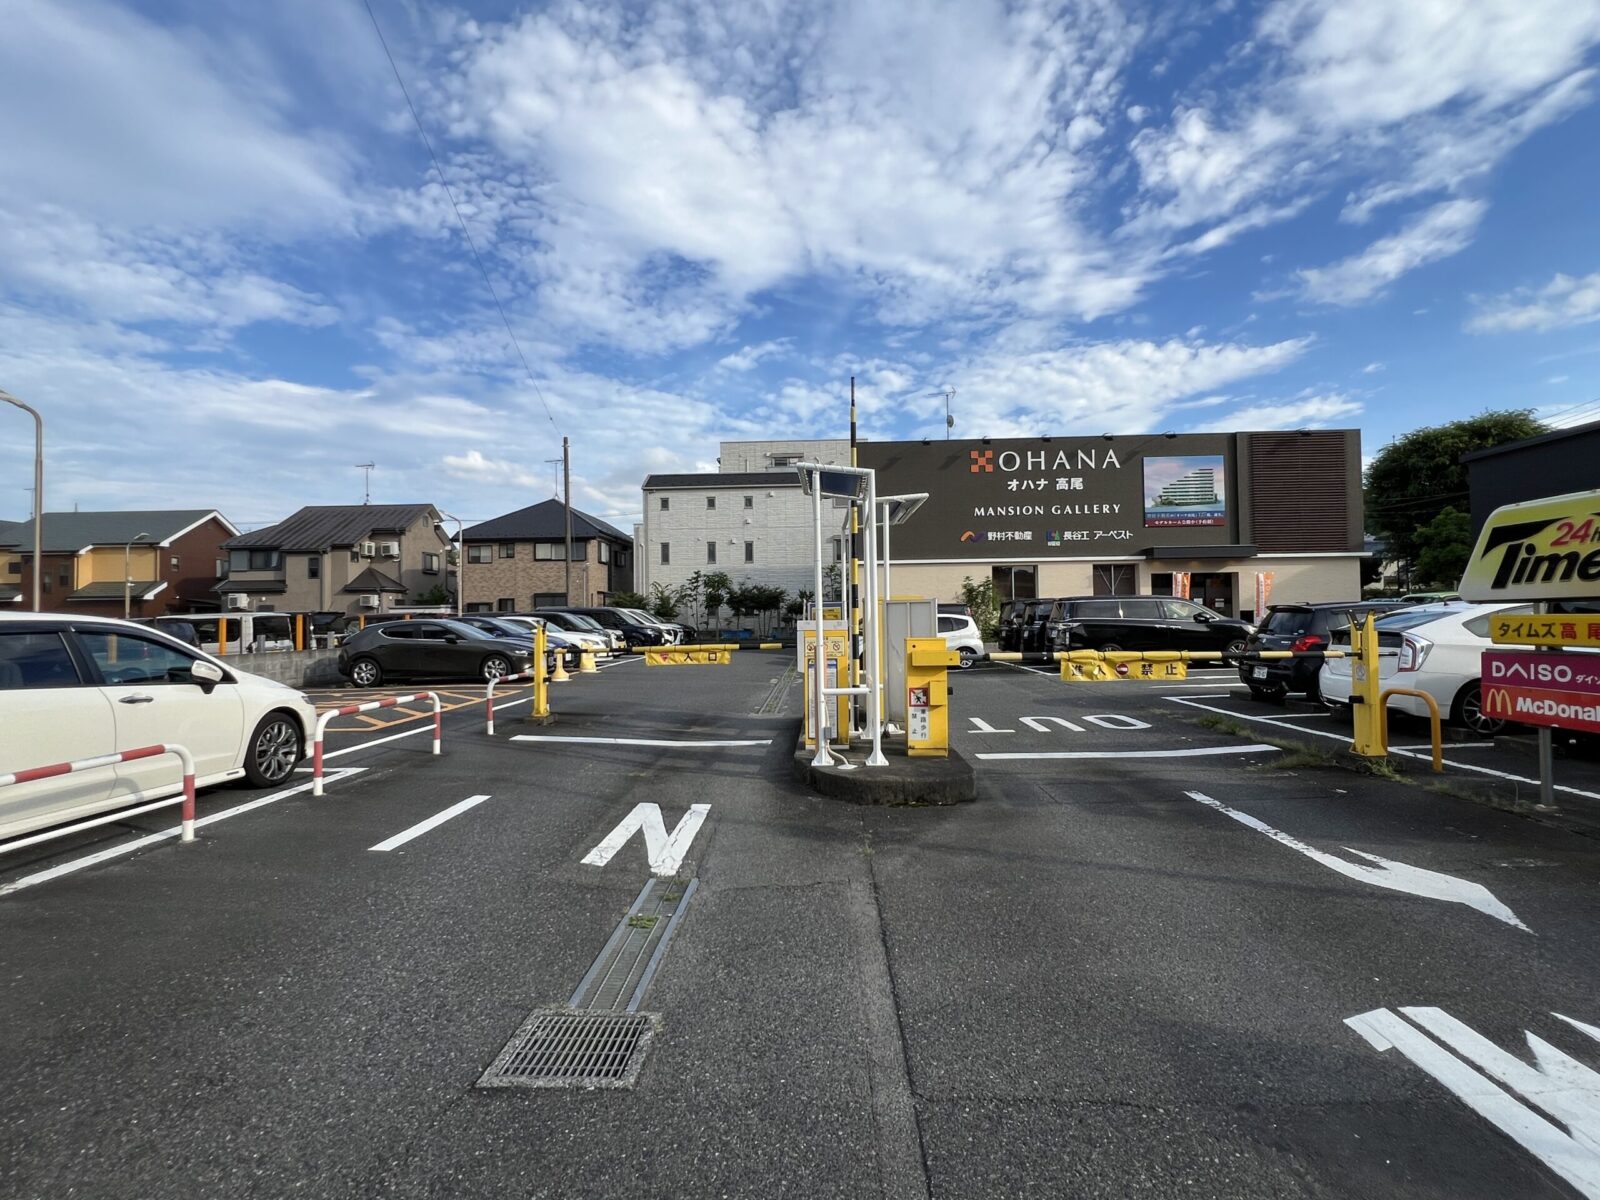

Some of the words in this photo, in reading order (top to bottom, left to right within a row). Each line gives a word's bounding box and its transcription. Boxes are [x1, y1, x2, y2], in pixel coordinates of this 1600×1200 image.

[998, 448, 1122, 472] OHANA
[1007, 478, 1049, 492] オハナ
[1055, 477, 1084, 490] 高尾
[973, 505, 1045, 517] MANSION
[1051, 503, 1121, 515] GALLERY
[987, 530, 1033, 541] 野村不動産
[1063, 531, 1090, 541] 長谷工
[684, 652, 718, 662] 入口
[1140, 663, 1178, 676] 禁止
[1491, 661, 1572, 683] DAISO
[968, 715, 1153, 733] OUT
